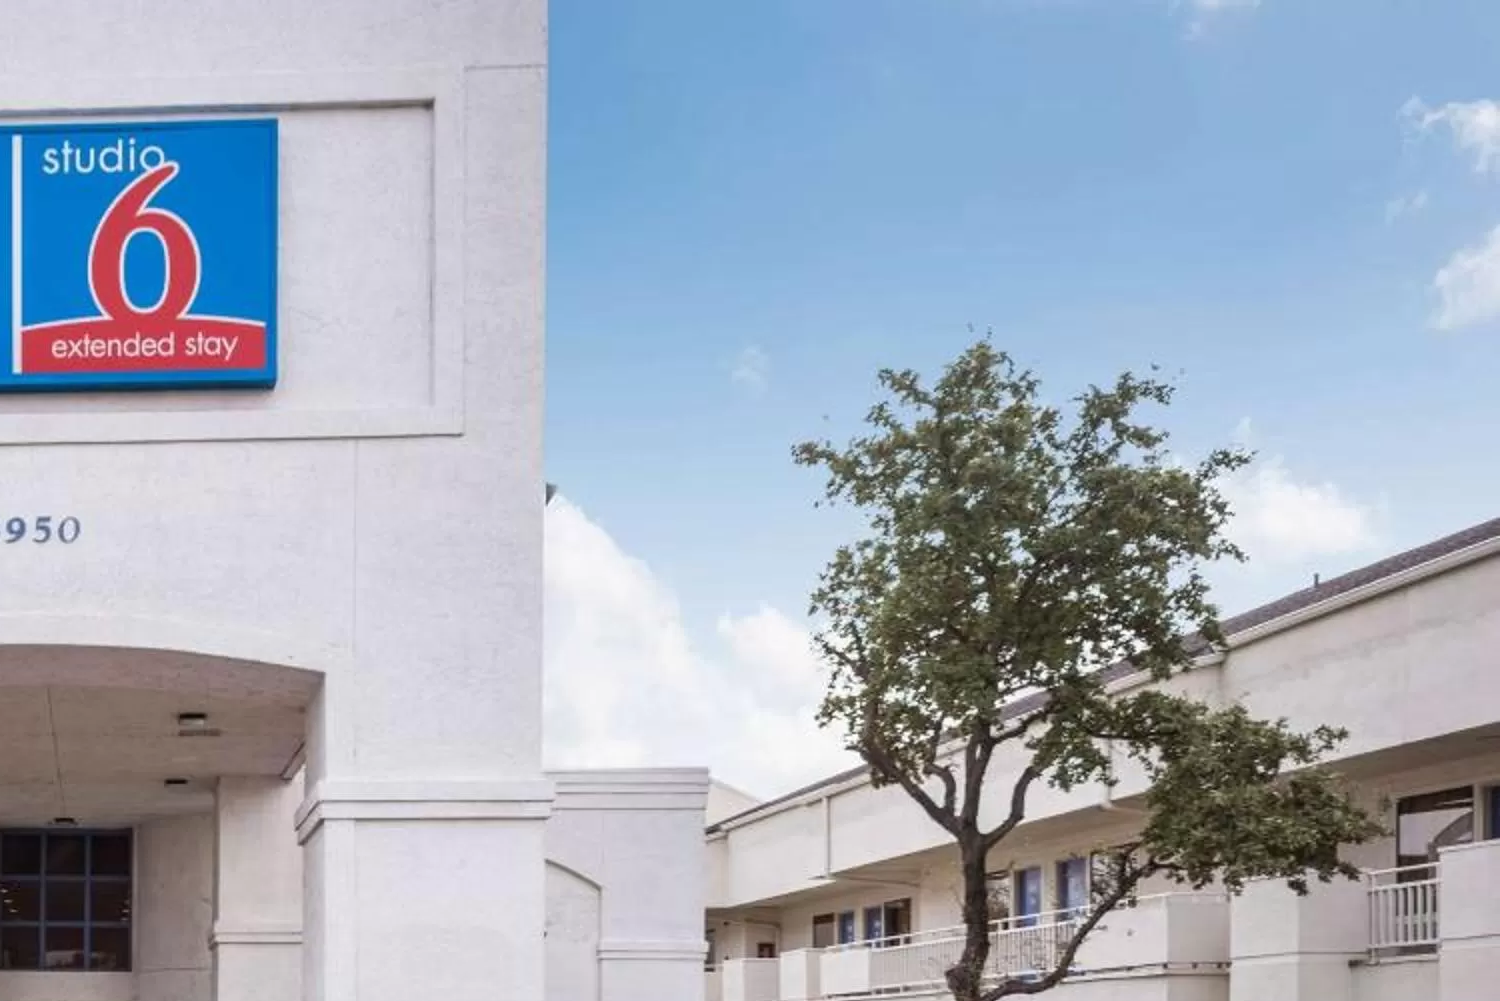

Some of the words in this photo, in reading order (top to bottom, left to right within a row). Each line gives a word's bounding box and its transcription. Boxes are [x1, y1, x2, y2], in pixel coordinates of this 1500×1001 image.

[42, 137, 165, 175] studio
[87, 160, 201, 322] 6
[51, 331, 175, 359] extended
[184, 330, 239, 361] stay
